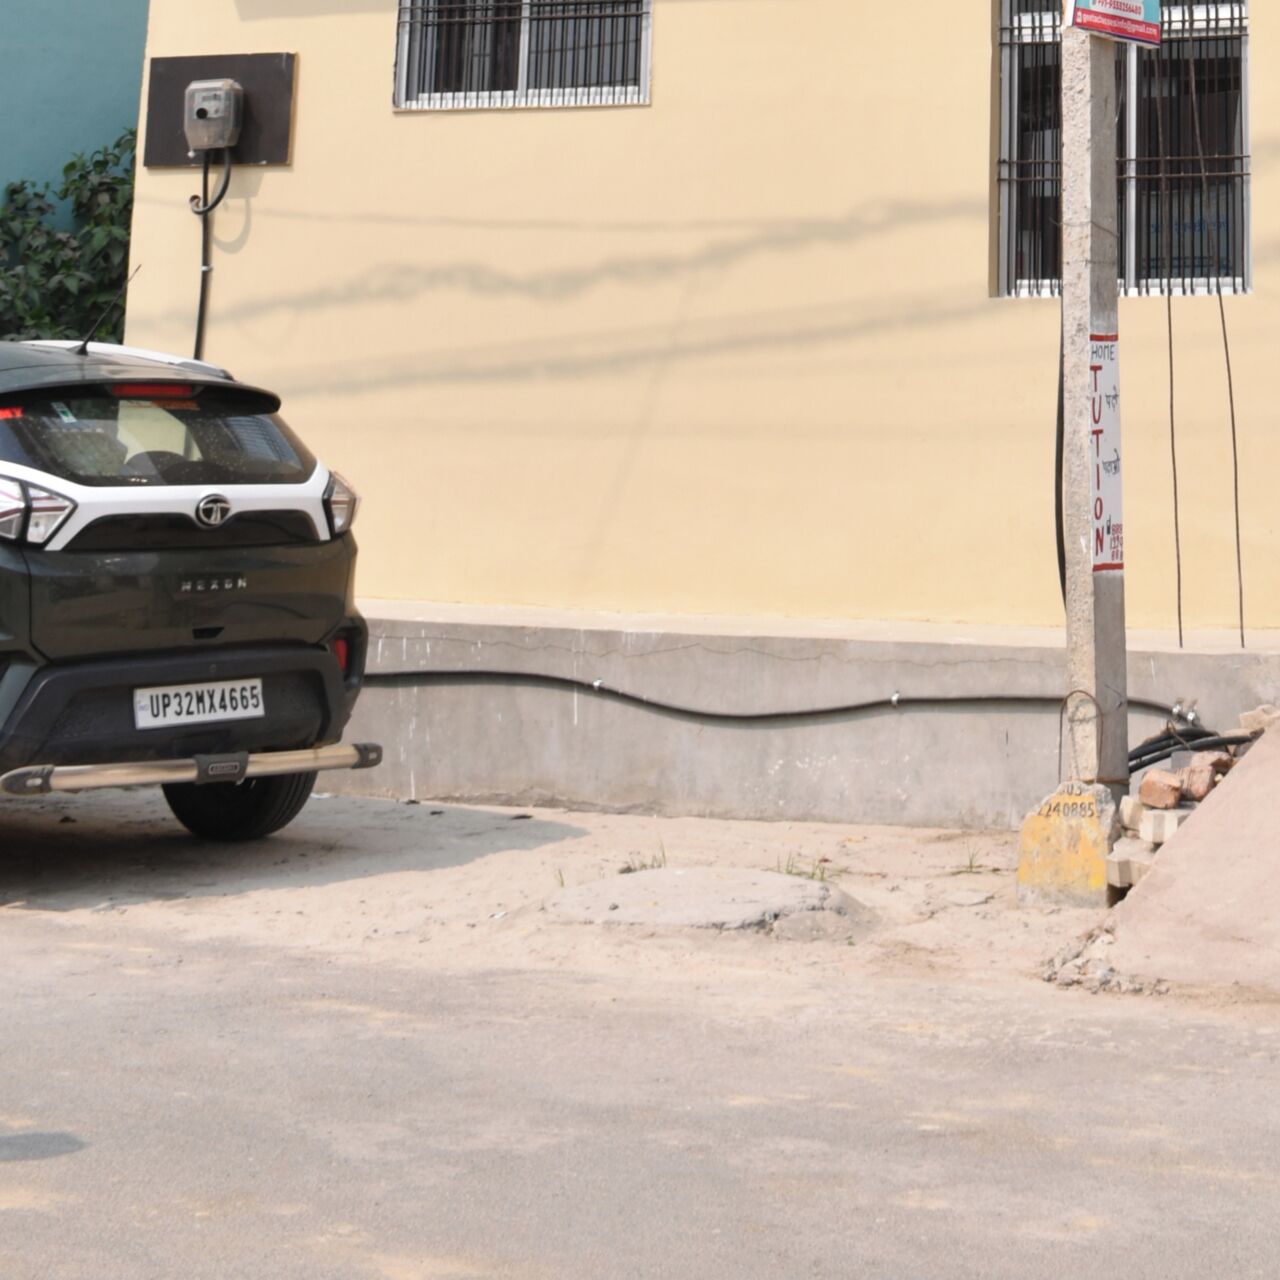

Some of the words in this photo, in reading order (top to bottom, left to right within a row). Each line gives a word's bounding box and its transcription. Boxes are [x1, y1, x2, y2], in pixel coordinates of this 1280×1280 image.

[1091, 344, 1115, 361] HOME
[181, 577, 248, 592] NEXON
[149, 685, 261, 719] UP32MX4665
